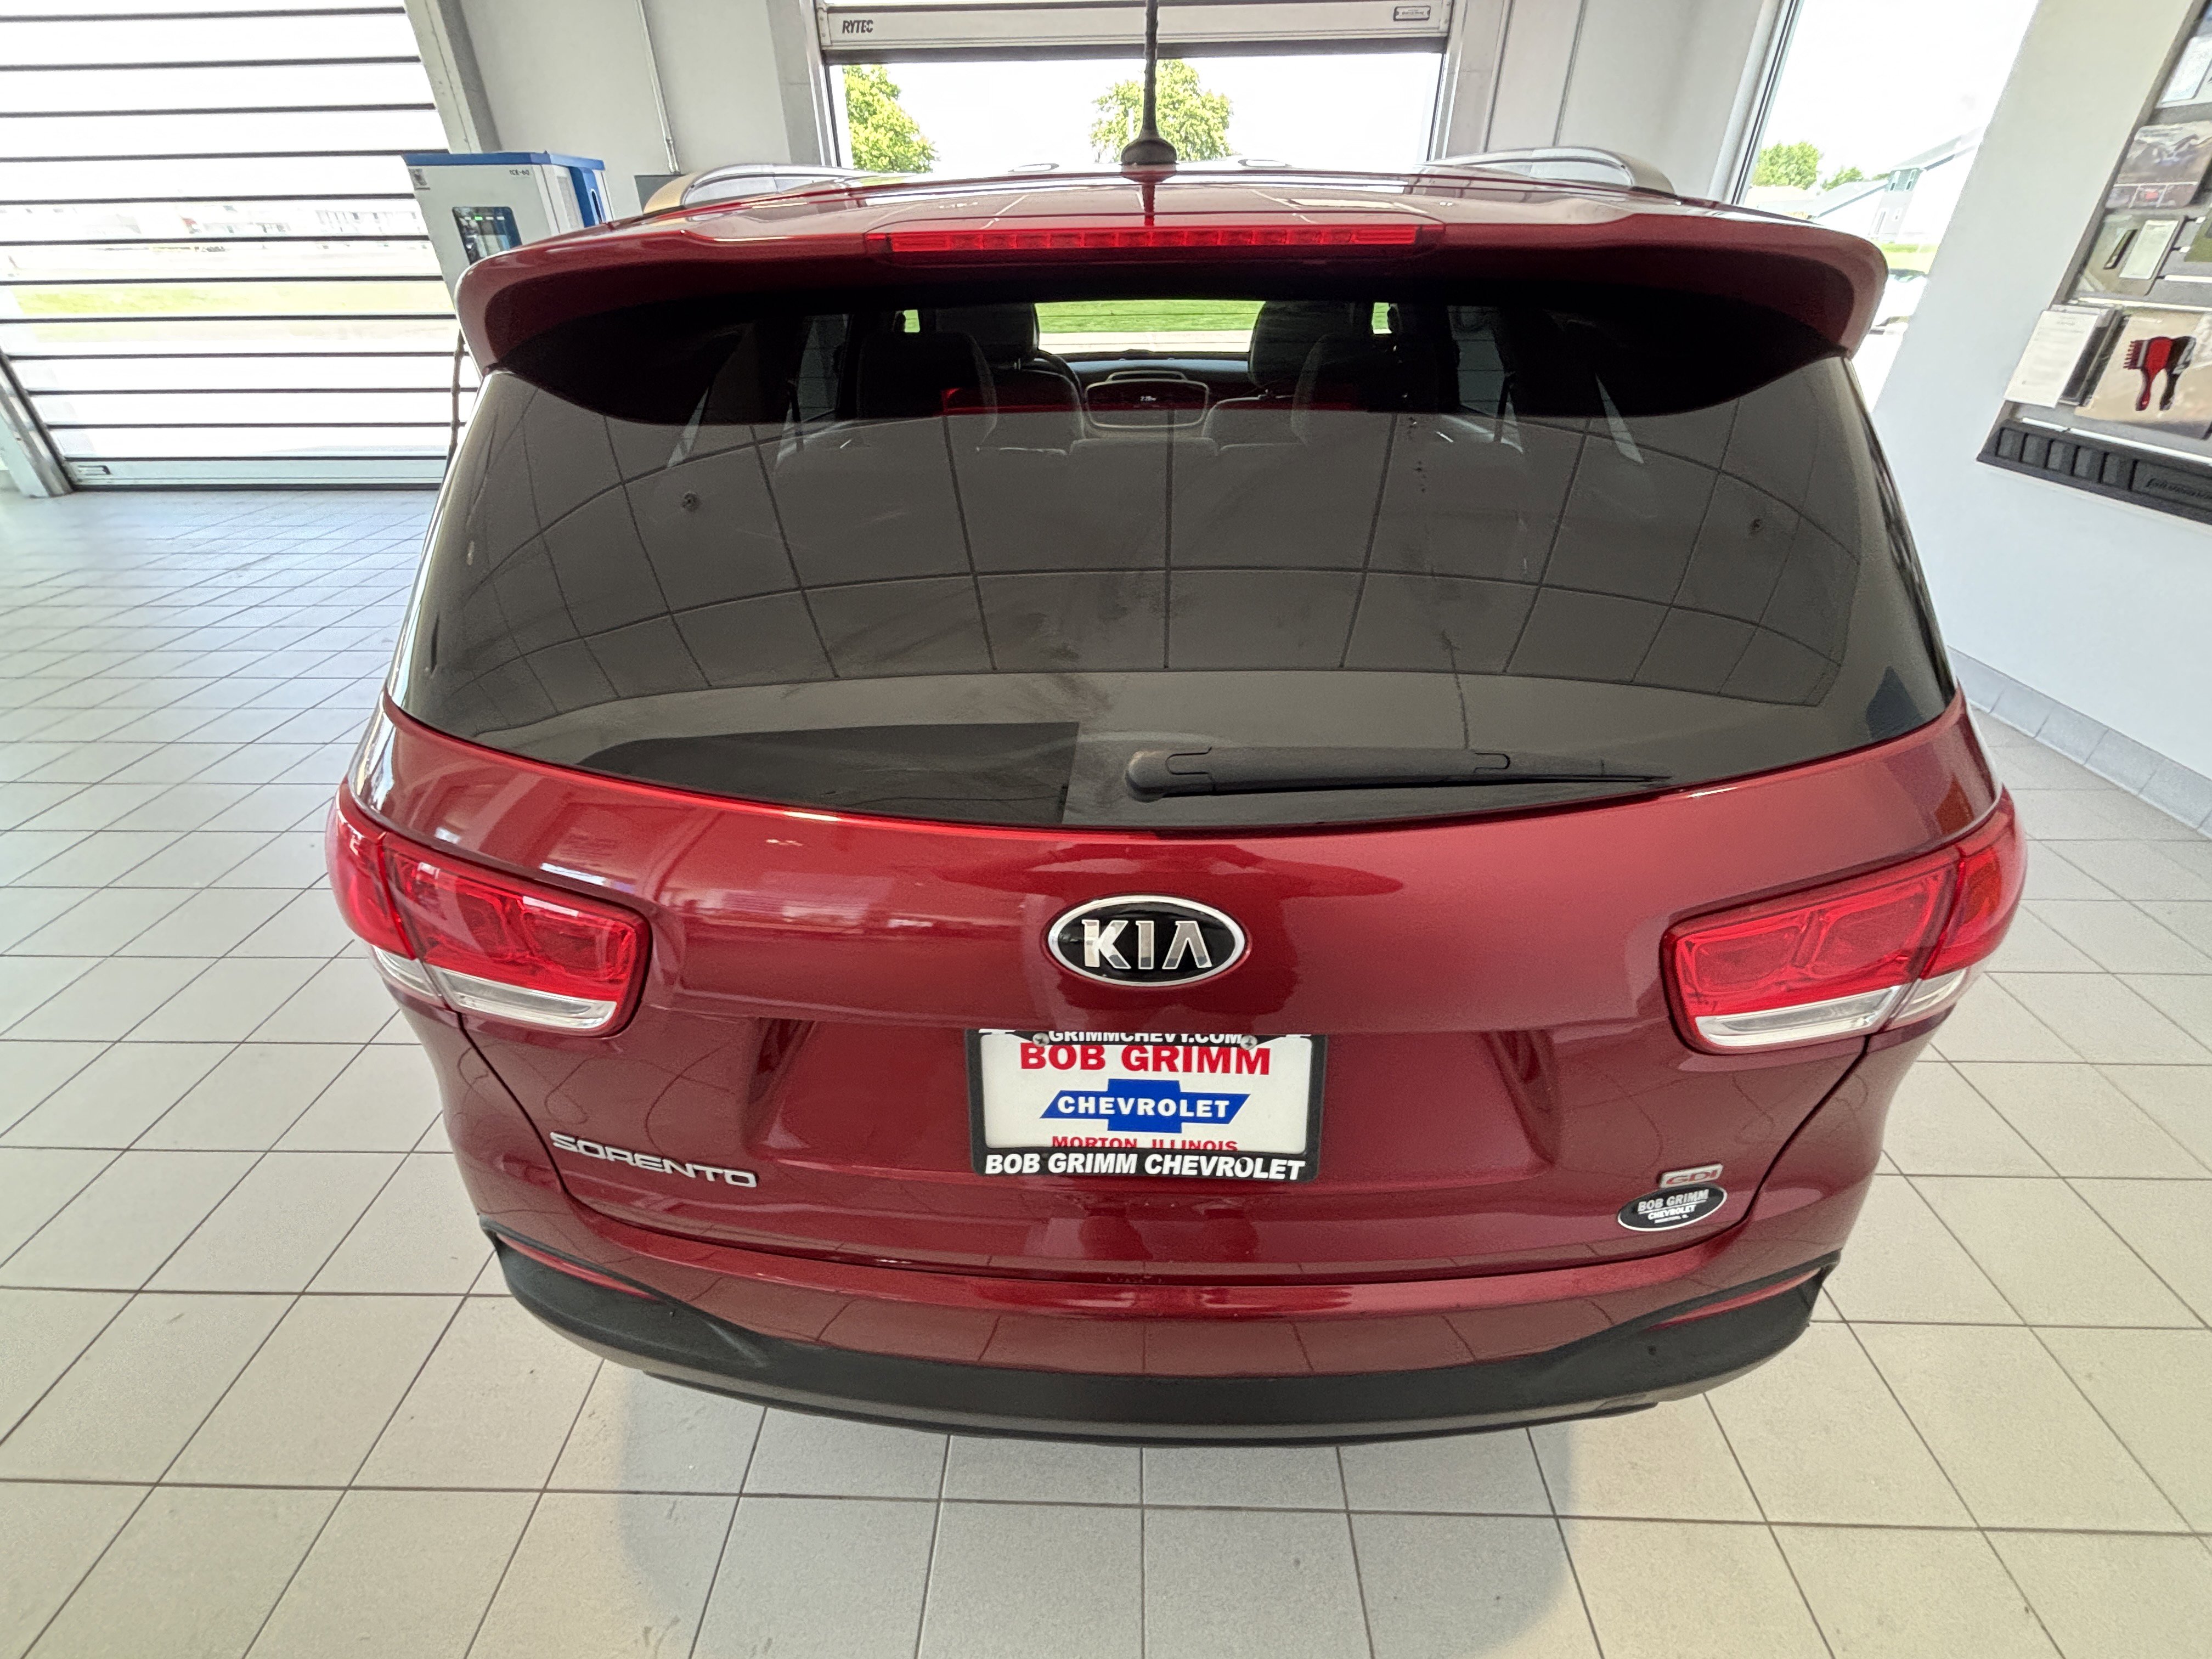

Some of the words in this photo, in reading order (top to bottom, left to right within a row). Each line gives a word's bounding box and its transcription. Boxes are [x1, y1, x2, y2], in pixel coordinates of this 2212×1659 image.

[842, 20, 874, 33] RYTEC
[1081, 919, 1212, 969] KIA
[1020, 1043, 1106, 1069] BOB
[1121, 1046, 1271, 1075] GRIMM
[1058, 1096, 1230, 1118] CHEVROLET
[1052, 1136, 1137, 1148] MORTON
[550, 1132, 757, 1188] SORENTO
[986, 1153, 1040, 1174] BOB
[1047, 1153, 1138, 1174] GRIMM
[1144, 1155, 1306, 1180] CHEVROLET
[1638, 1198, 1664, 1212] BOB
[1666, 1189, 1709, 1206] GRIMM
[1648, 1205, 1696, 1220] CHEVROLET
